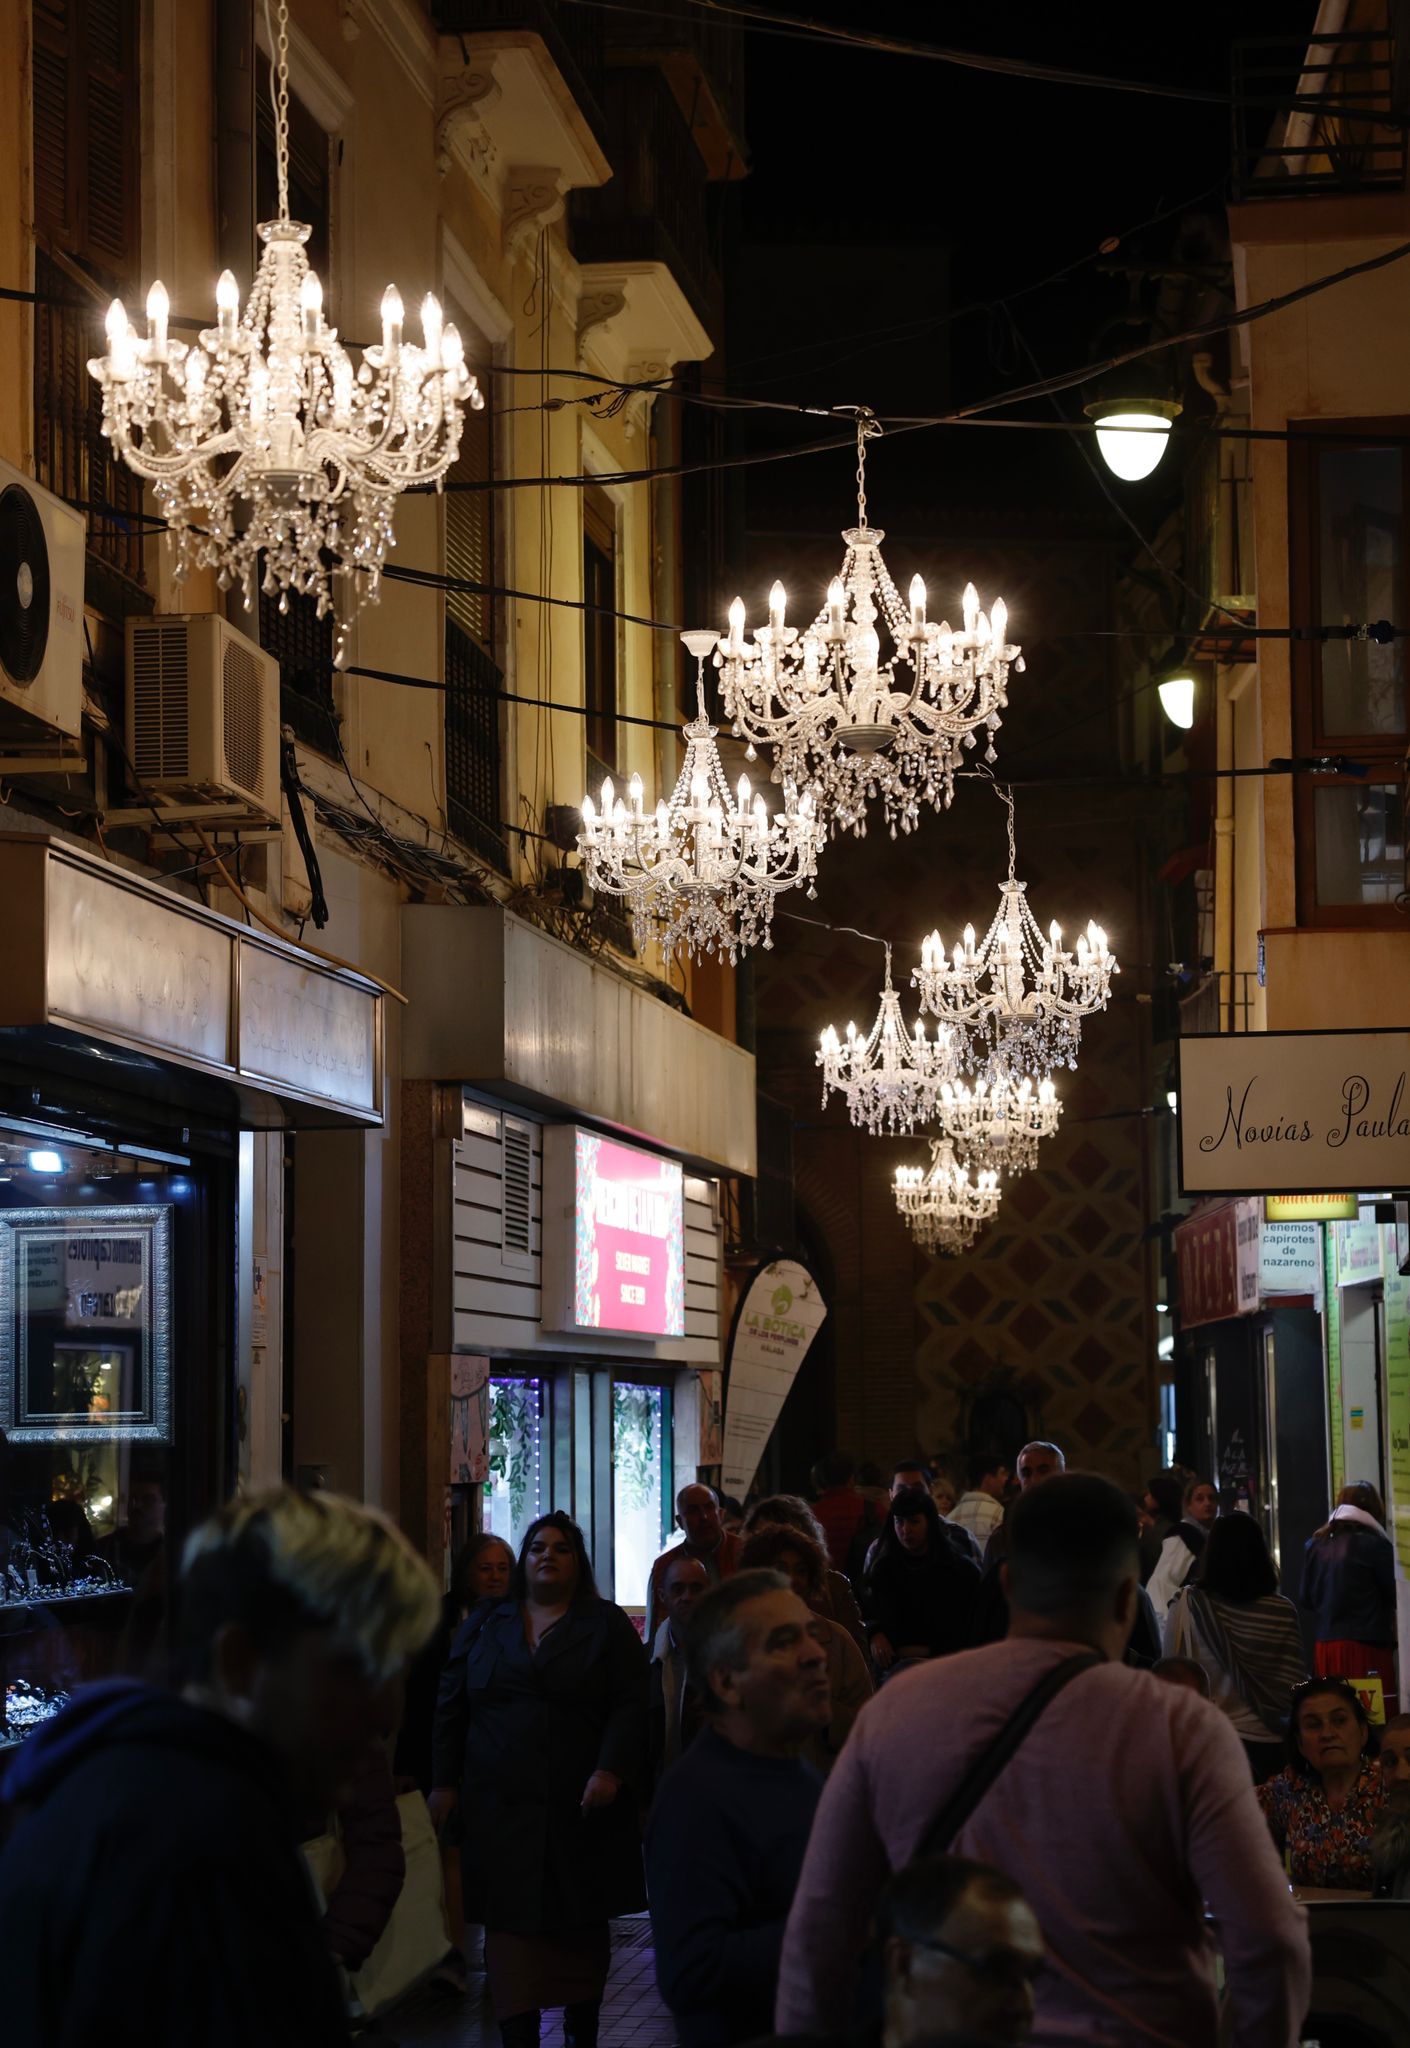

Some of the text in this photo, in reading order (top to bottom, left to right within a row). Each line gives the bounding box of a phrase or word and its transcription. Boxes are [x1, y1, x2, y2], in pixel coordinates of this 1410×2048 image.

[1199, 1071, 1410, 1153] Novias Paula
[1263, 1234, 1315, 1248] capirotes
[1282, 1245, 1296, 1256] de
[1263, 1257, 1315, 1268] nazareno
[745, 1311, 807, 1341] LA BOTICA
